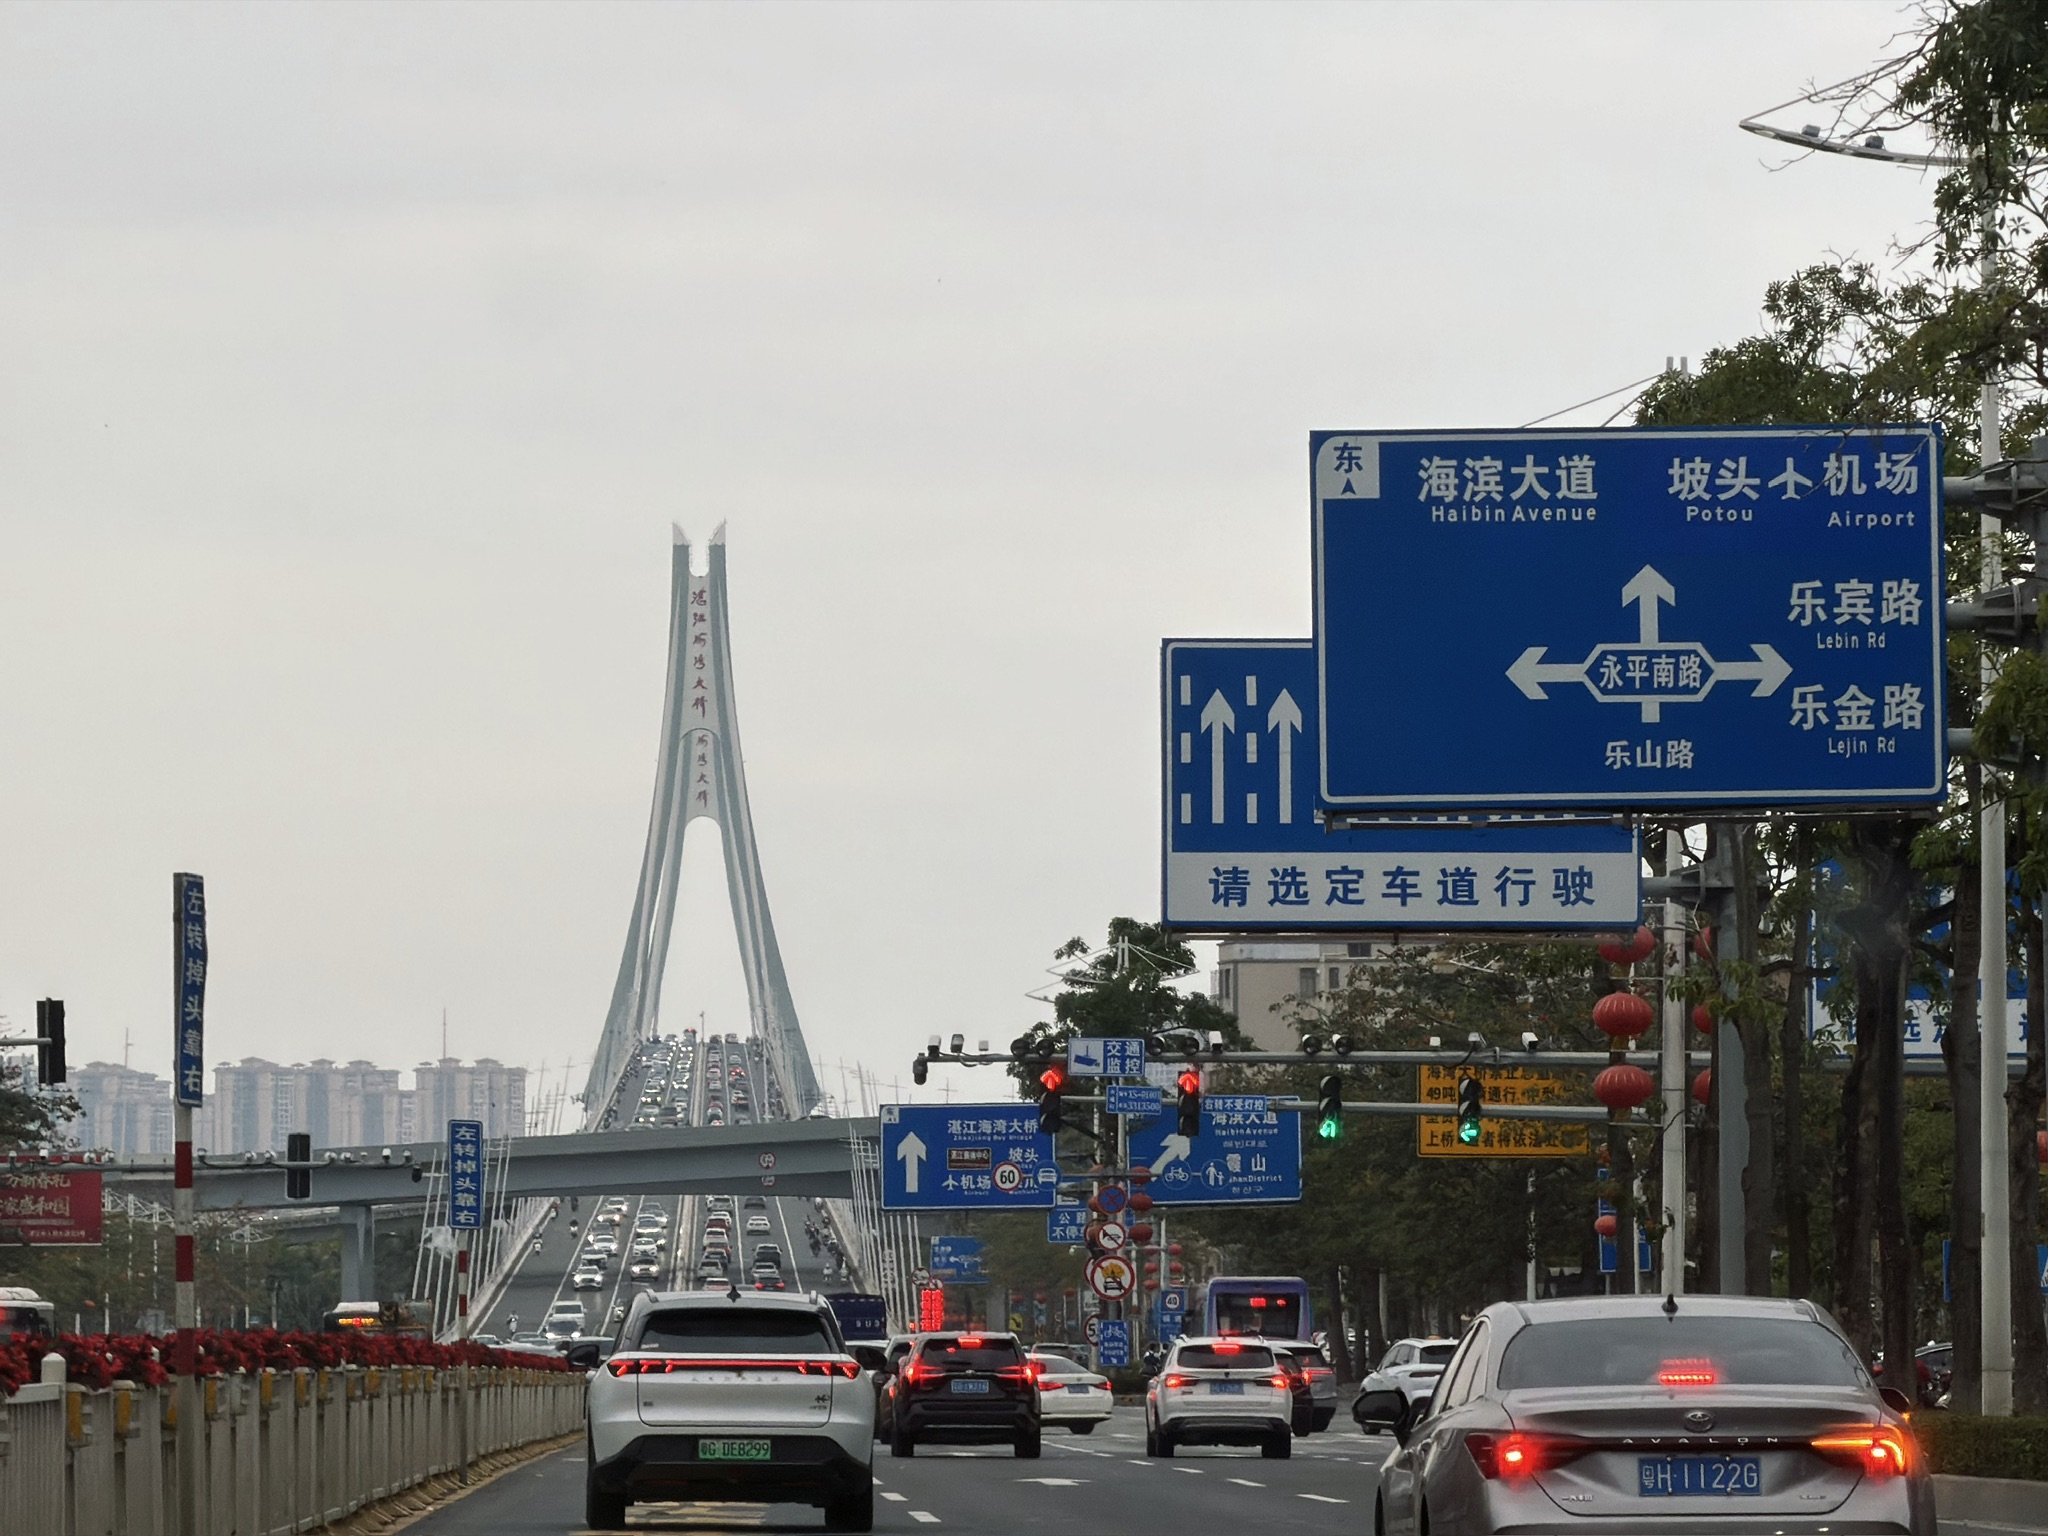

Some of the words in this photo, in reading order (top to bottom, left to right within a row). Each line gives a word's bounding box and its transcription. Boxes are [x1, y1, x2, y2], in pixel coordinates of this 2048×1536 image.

[1333, 442, 1364, 472] 东
[1418, 455, 1598, 502] 海滨大道
[1668, 456, 1761, 502] 坡头
[1823, 452, 1920, 496] 机场
[1432, 504, 1505, 523] Haibin
[1512, 504, 1597, 523] Avenue
[1687, 505, 1753, 522] Potou
[1828, 510, 1915, 529] Airport
[1788, 578, 1923, 626] 乐宾路
[1817, 631, 1859, 649] Lebin
[1867, 631, 1886, 649] Rd
[1599, 655, 1703, 691] 永平南路
[1789, 683, 1926, 731] 乐金路
[1604, 740, 1695, 770] 乐山路
[1829, 736, 1868, 759] Lejin
[1877, 736, 1896, 754] Rd
[1209, 865, 1596, 908] 请选定车道行驶
[1106, 1041, 1140, 1056] 交通
[1106, 1057, 1140, 1073] 监控
[1204, 1098, 1264, 1112] 右转不受灯控
[947, 1118, 1039, 1135] 湛江海湾大桥
[1008, 1147, 1039, 1163] 坡头
[1226, 1153, 1266, 1173] 霞山
[453, 1126, 477, 1224] 左转掉头靠右
[960, 1174, 991, 1190] 机场
[1000, 1170, 1016, 1184] 60
[722, 1442, 769, 1456] DE8299
[1623, 1437, 1778, 1446] AVALON
